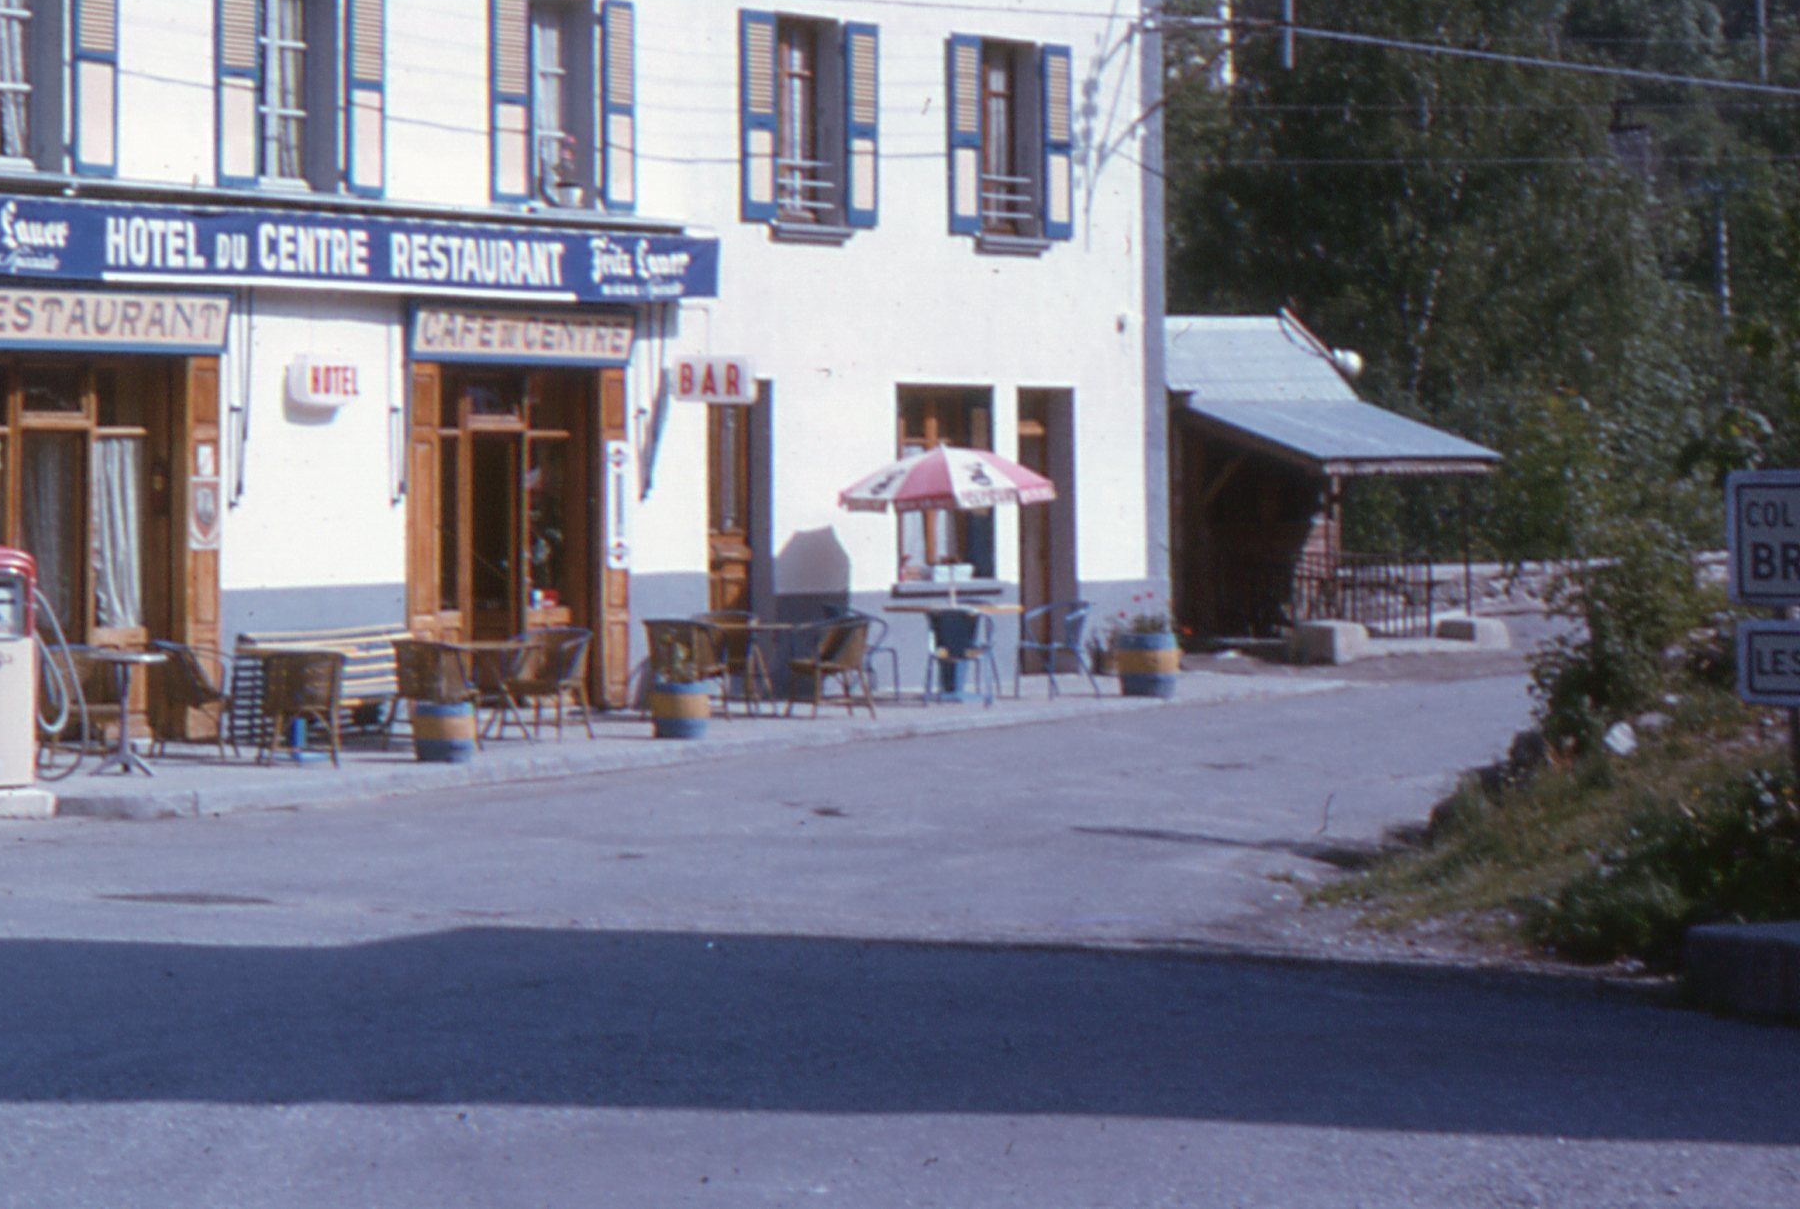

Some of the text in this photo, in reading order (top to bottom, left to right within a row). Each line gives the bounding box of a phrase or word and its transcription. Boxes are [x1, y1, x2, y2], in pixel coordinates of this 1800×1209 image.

[105, 216, 206, 270] HOTEL
[216, 232, 248, 271] DU
[257, 222, 370, 276] CENTRE
[389, 231, 565, 287] RESTAURANT
[310, 363, 360, 397] HOTEL
[678, 361, 742, 397] BAR
[1745, 500, 1794, 528] COL
